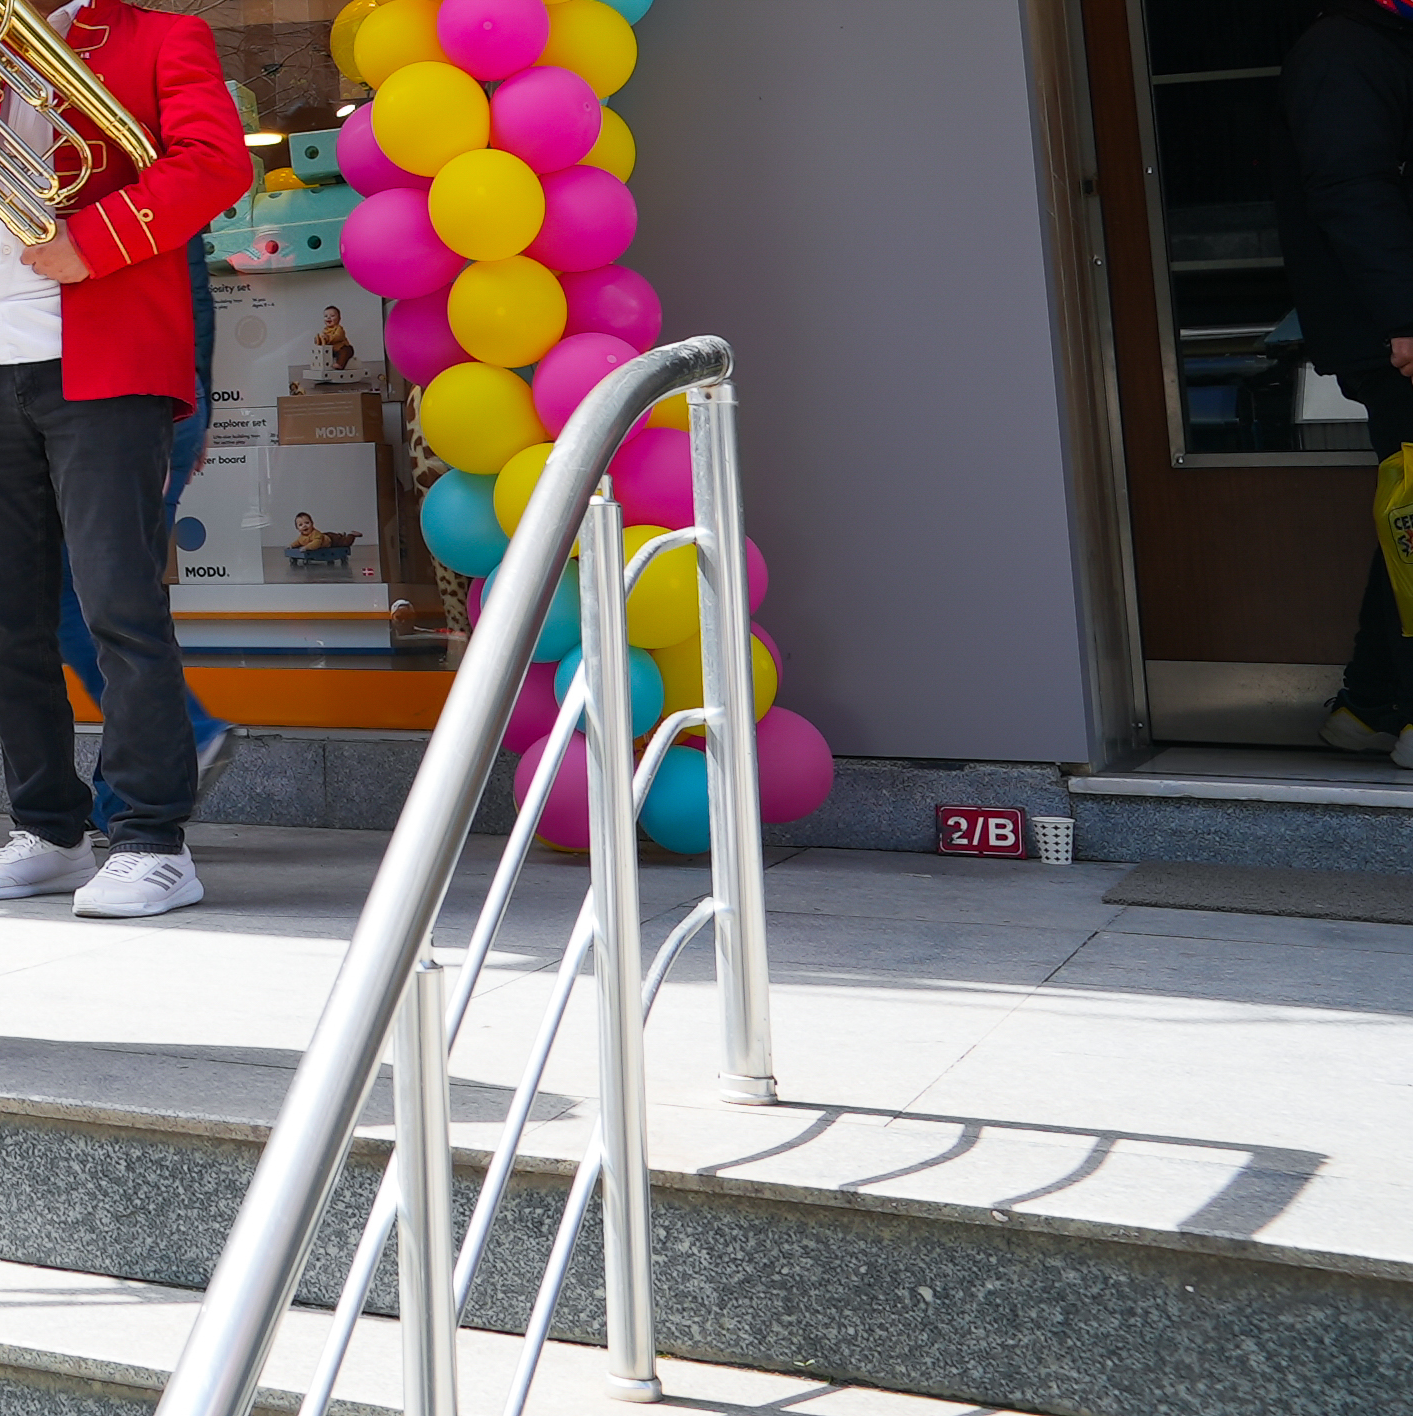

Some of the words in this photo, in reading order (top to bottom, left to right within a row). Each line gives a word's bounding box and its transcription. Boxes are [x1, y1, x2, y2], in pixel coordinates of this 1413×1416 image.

[209, 283, 235, 295] iosity
[211, 390, 244, 402] ODU.
[213, 418, 249, 431] explorer
[218, 454, 247, 465] board
[947, 816, 1016, 847] 2/B
